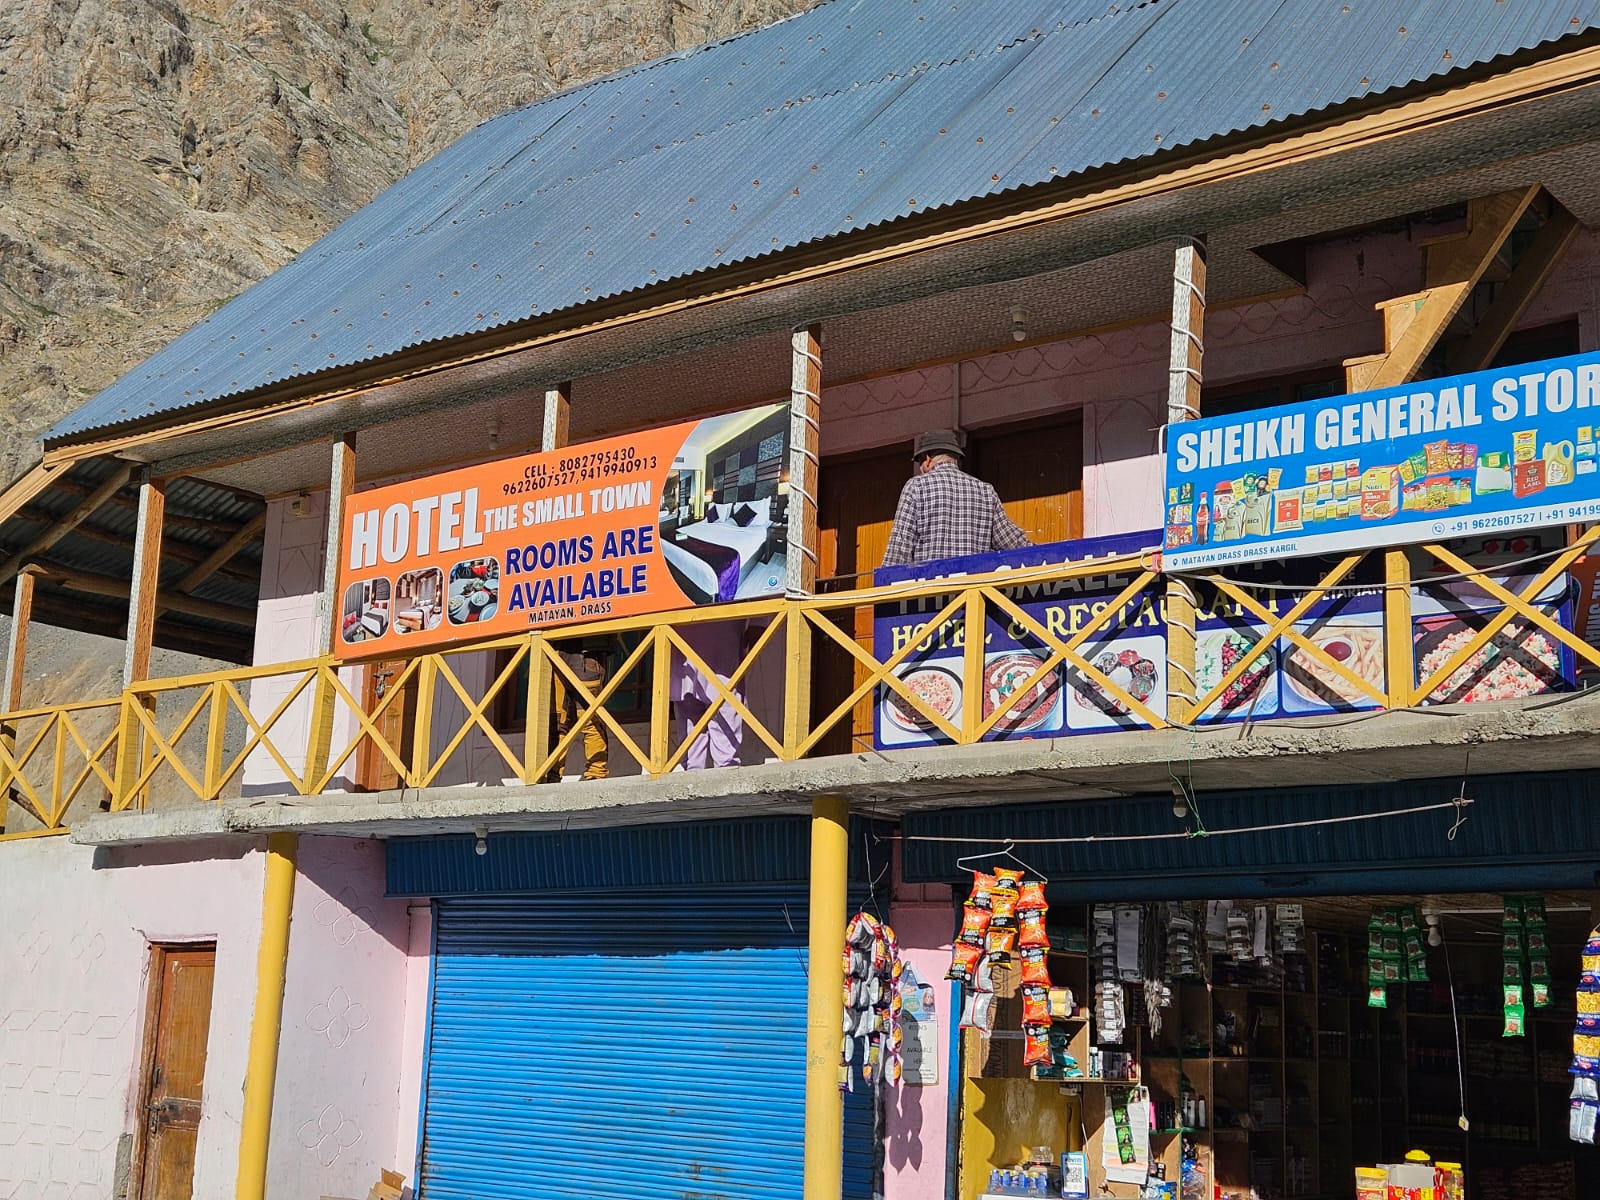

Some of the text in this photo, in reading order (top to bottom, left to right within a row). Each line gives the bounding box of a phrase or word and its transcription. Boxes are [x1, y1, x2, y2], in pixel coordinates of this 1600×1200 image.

[1176, 413, 1305, 473] SHEIKH
[1314, 383, 1482, 450] GENERAL
[502, 456, 658, 496] 9622607527,9419940913
[524, 464, 547, 480] CELL
[559, 446, 636, 473] 8082795430
[483, 480, 653, 533] THE SMALL TOWN
[1451, 520, 1468, 532] +91
[1472, 512, 1535, 529] 9622607527
[1546, 510, 1564, 520] +91
[350, 488, 484, 570] HOTEL
[504, 525, 655, 576] ROOMS ARE
[1181, 543, 1298, 565] MATAYAN DRASS DRASS KARGIL
[507, 565, 648, 612] AVAILABLE
[528, 602, 612, 624] MATAYAN, DRASS
